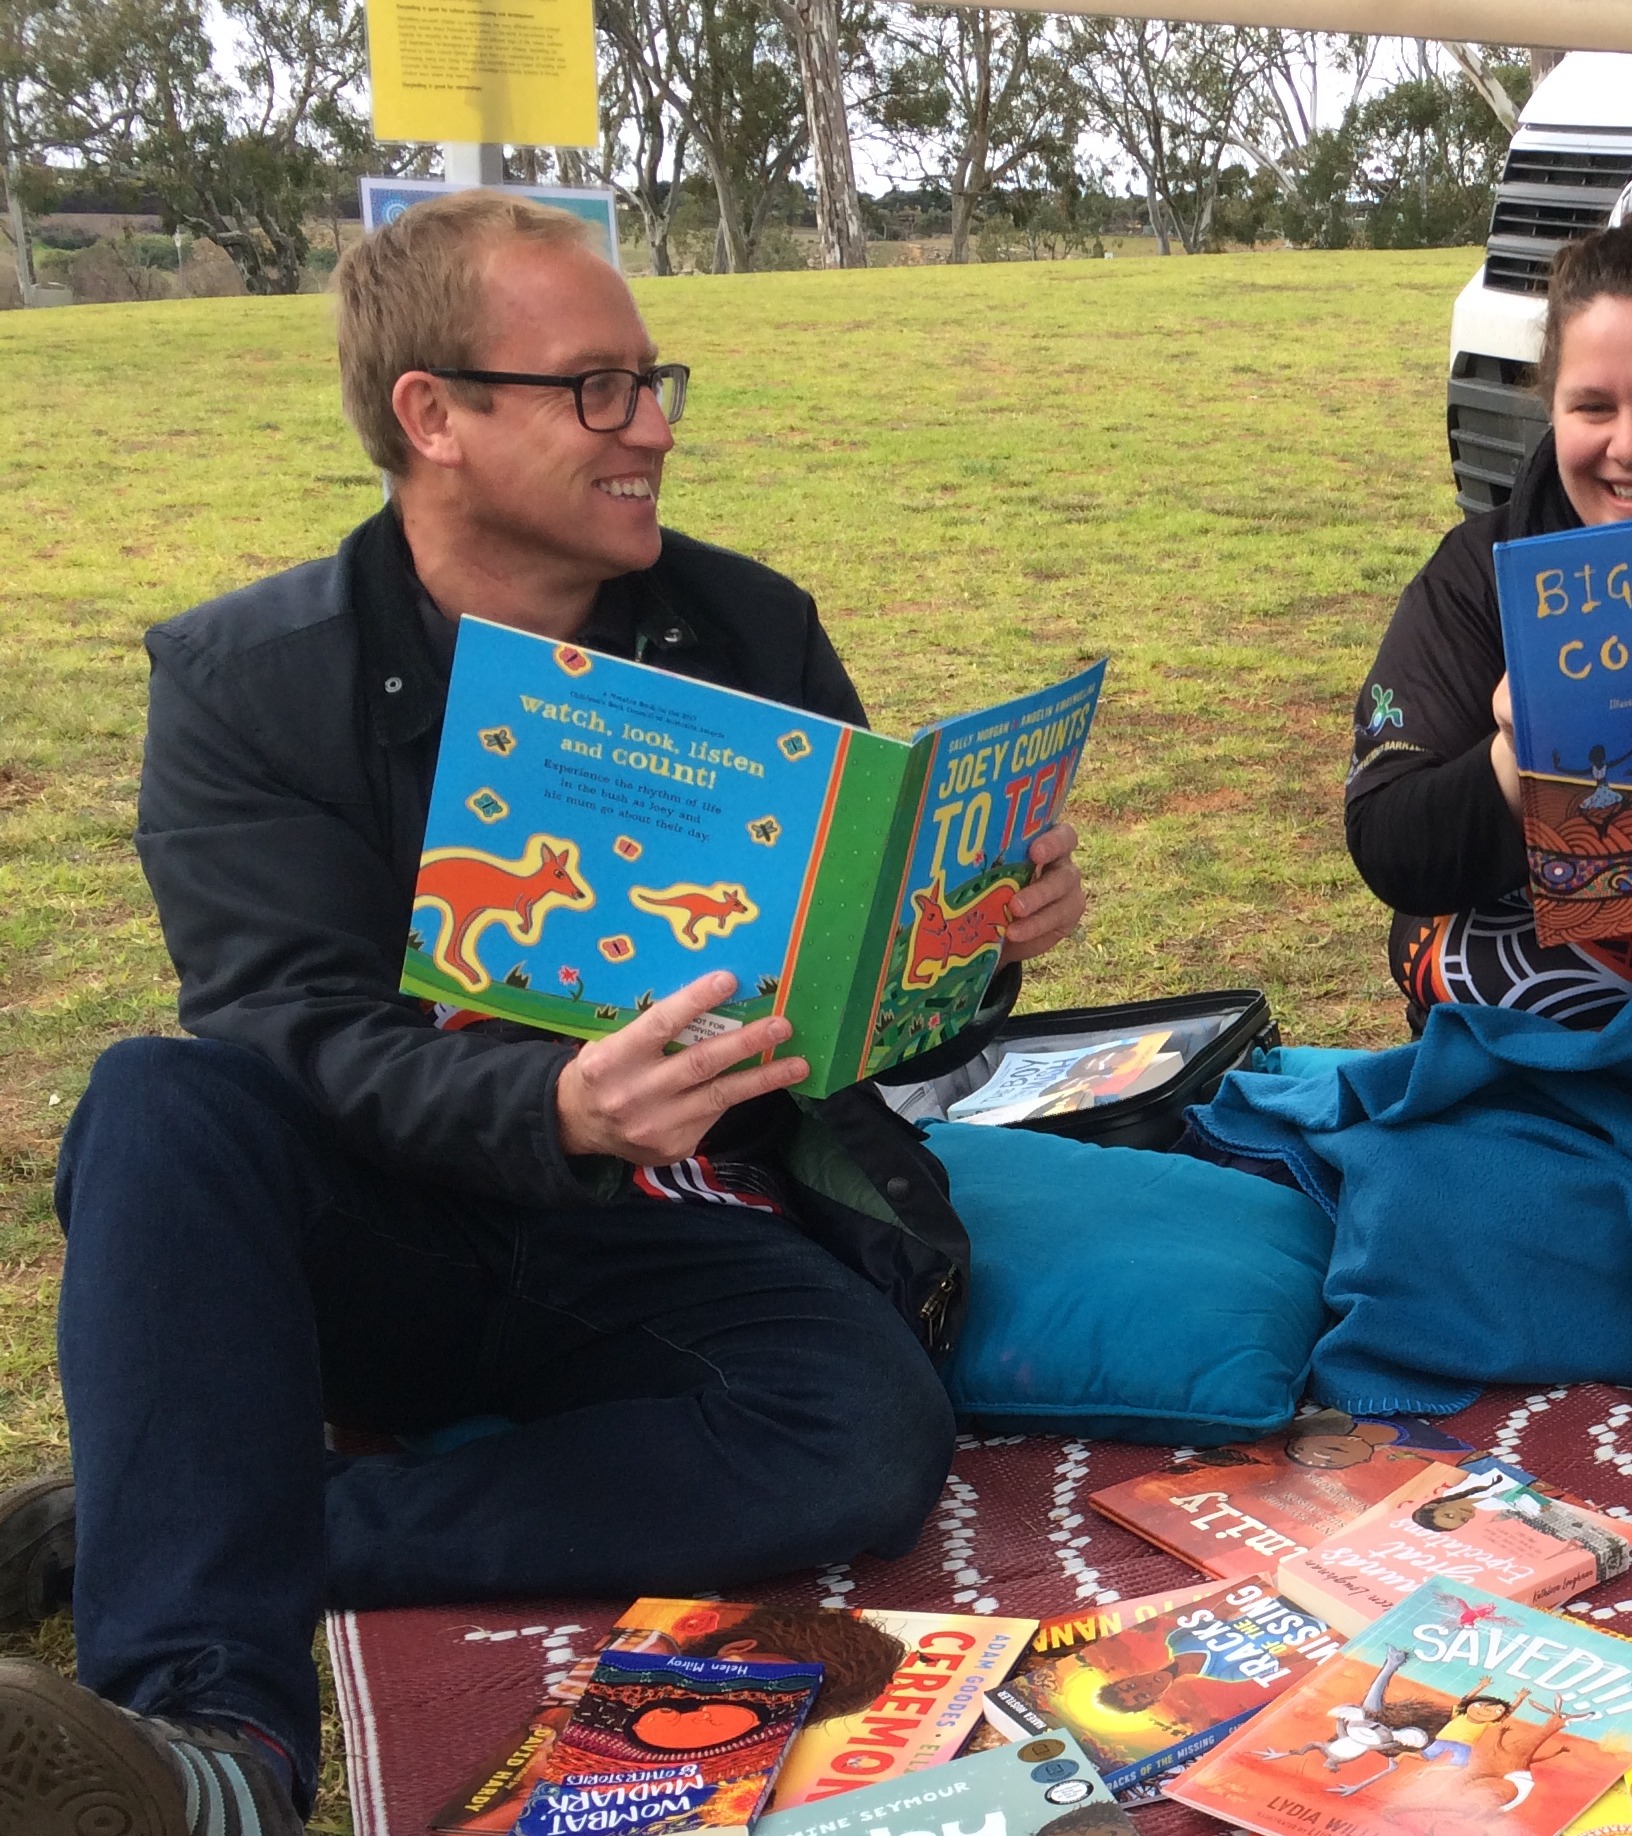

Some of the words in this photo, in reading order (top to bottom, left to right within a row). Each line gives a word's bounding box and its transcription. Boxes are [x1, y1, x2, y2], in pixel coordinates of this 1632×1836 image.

[560, 736, 604, 760] and
[611, 747, 718, 791] count!
[688, 741, 766, 779] listen
[938, 741, 1010, 800] JOEY
[1010, 702, 1091, 774] COUNTS
[948, 734, 975, 752] SALLY
[543, 758, 611, 785] Experience
[614, 776, 634, 791] the
[637, 784, 683, 805] rhythm
[685, 796, 697, 808] of
[702, 800, 723, 815] life
[560, 778, 573, 789] in
[577, 782, 597, 796] the
[600, 788, 629, 804] bush
[633, 798, 646, 808] as
[650, 802, 675, 818] Joey
[679, 811, 702, 825] and
[543, 788, 562, 801] his
[565, 795, 597, 811] mum
[600, 804, 614, 816] go
[618, 808, 651, 825] about
[655, 818, 684, 834] their
[929, 790, 992, 877] TO
[998, 744, 1079, 851] TEN
[708, 1021, 726, 1031] FOR
[1388, 1517, 1536, 1586] Expectations
[1225, 1583, 1342, 1666] MISSING
[1231, 1618, 1264, 1645] THE
[666, 1656, 704, 1674] Milroy
[976, 1633, 1009, 1673] ADAM
[1176, 1610, 1292, 1690] TRACKS
[1264, 1638, 1287, 1658] OF
[710, 1661, 748, 1677] Helen
[935, 1675, 977, 1729] GOODES
[506, 1727, 550, 1768] DAVID
[1139, 1763, 1153, 1777] OF
[1155, 1753, 1175, 1769] THE
[1176, 1735, 1216, 1759] MISSING
[464, 1763, 512, 1812] HARDY
[564, 1772, 624, 1788] STORIES
[623, 1769, 677, 1784] OTHER
[678, 1763, 700, 1780] &
[548, 1775, 705, 1814] MUDLARK
[859, 1781, 971, 1823] SEYMOUR
[1266, 1796, 1322, 1825] LYDIA
